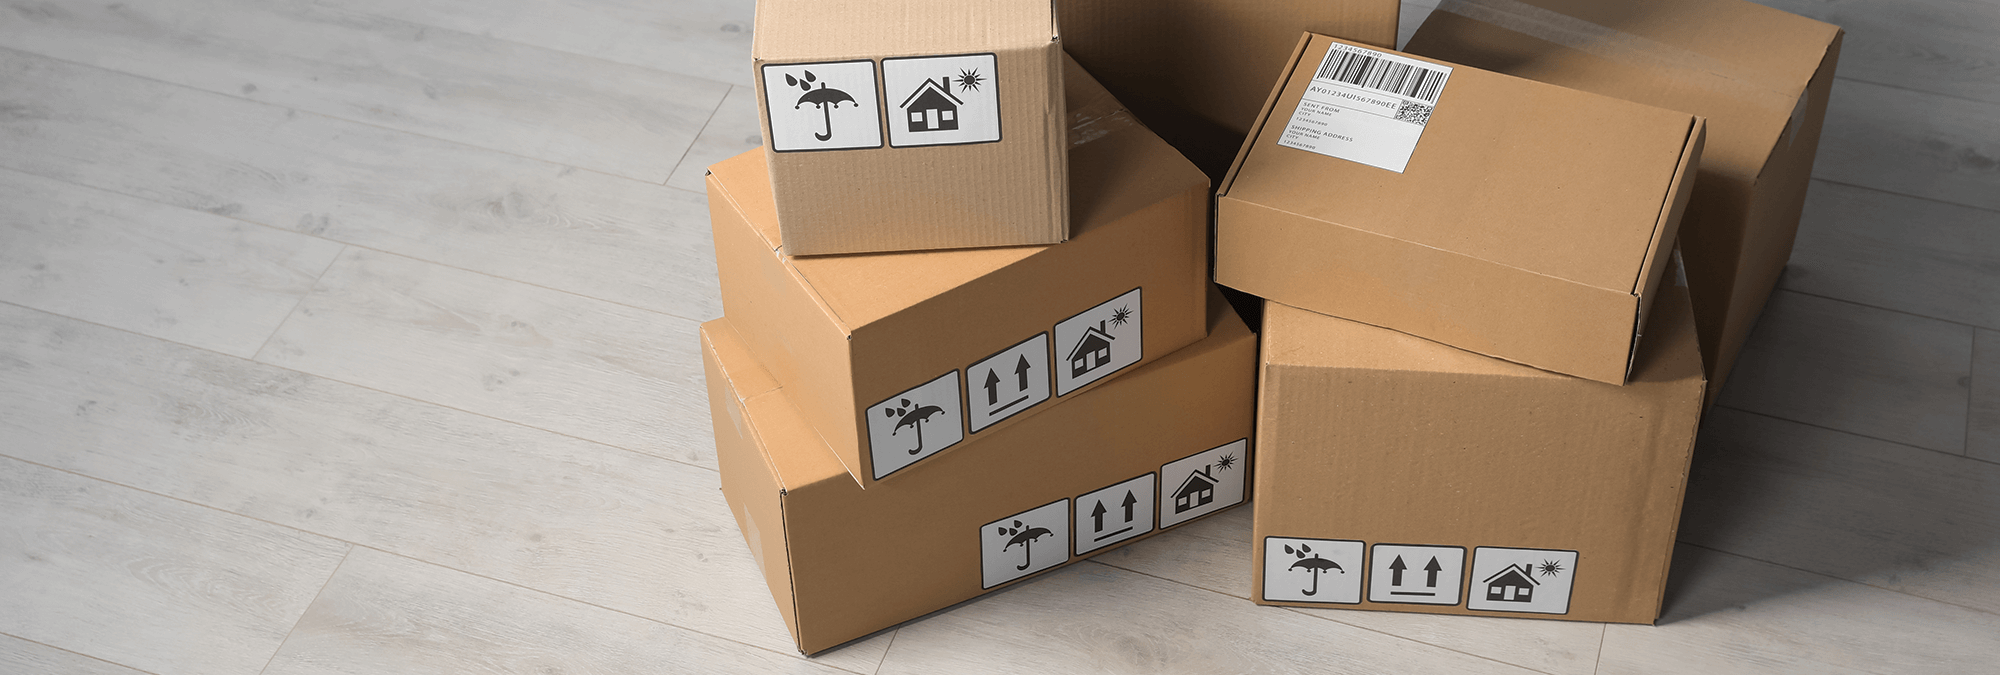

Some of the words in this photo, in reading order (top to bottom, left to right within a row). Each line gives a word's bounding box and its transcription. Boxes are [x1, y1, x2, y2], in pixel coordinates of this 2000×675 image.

[1333, 44, 1382, 58] 1234567890
[1296, 117, 1328, 126] 1234567890
[1291, 125, 1321, 135] SHIPPING
[1323, 132, 1353, 142] ADDRESS
[1283, 140, 1316, 150] 1234567890
